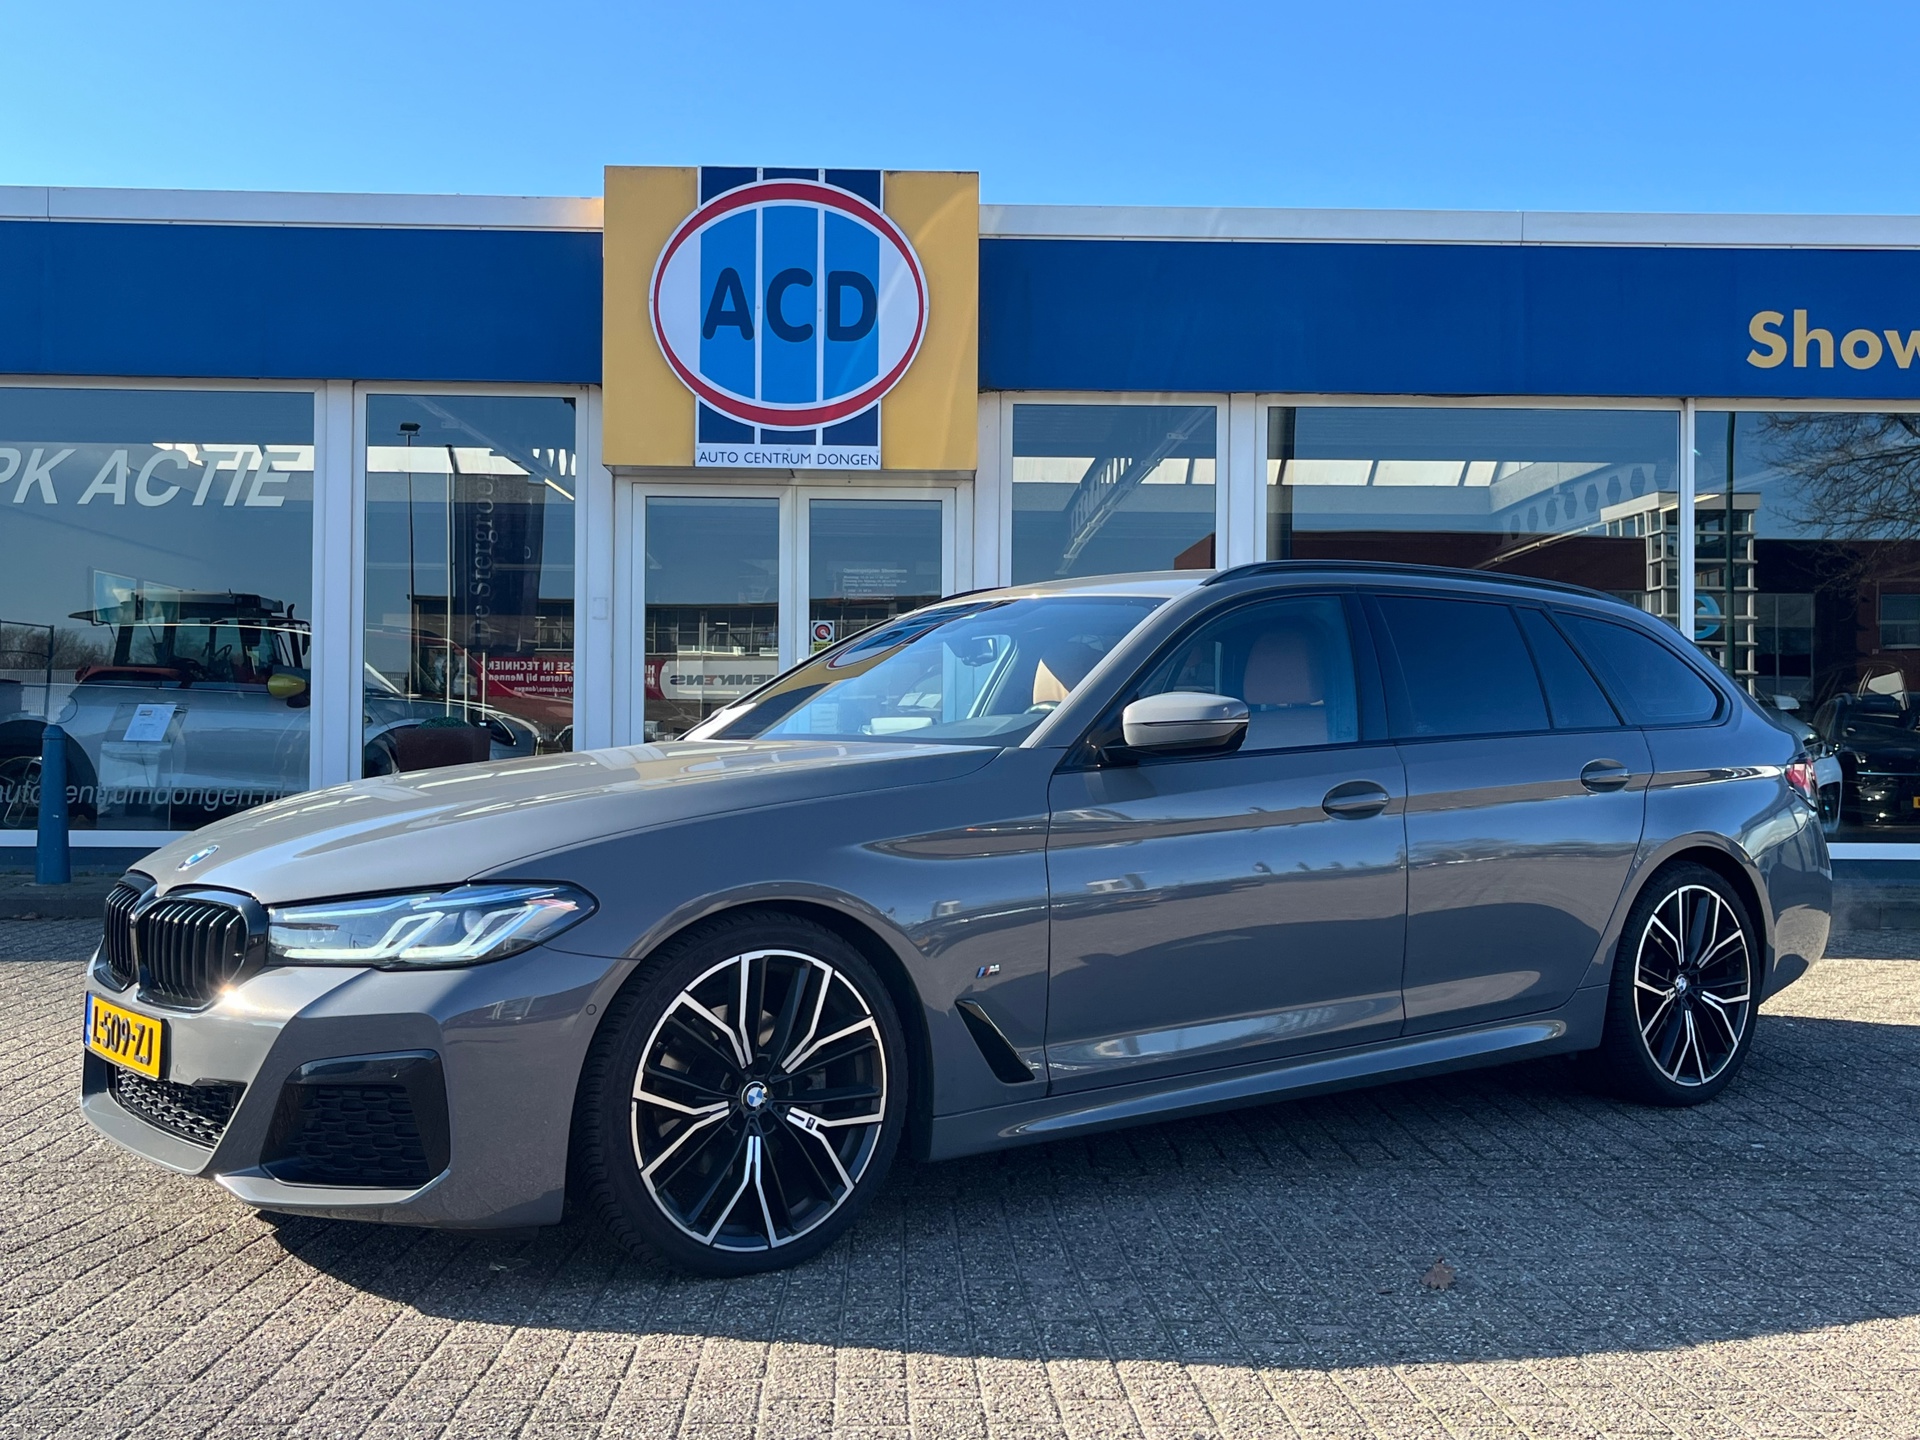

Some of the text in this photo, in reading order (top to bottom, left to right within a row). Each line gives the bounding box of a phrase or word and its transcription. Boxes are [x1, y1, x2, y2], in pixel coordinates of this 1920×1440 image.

[702, 267, 878, 343] ACD
[1746, 309, 1920, 370] Show
[77, 449, 301, 507] ACTIE
[698, 451, 879, 467] AUTO CENTRUM DONGEN
[92, 1005, 154, 1067] L-509-ZJ
